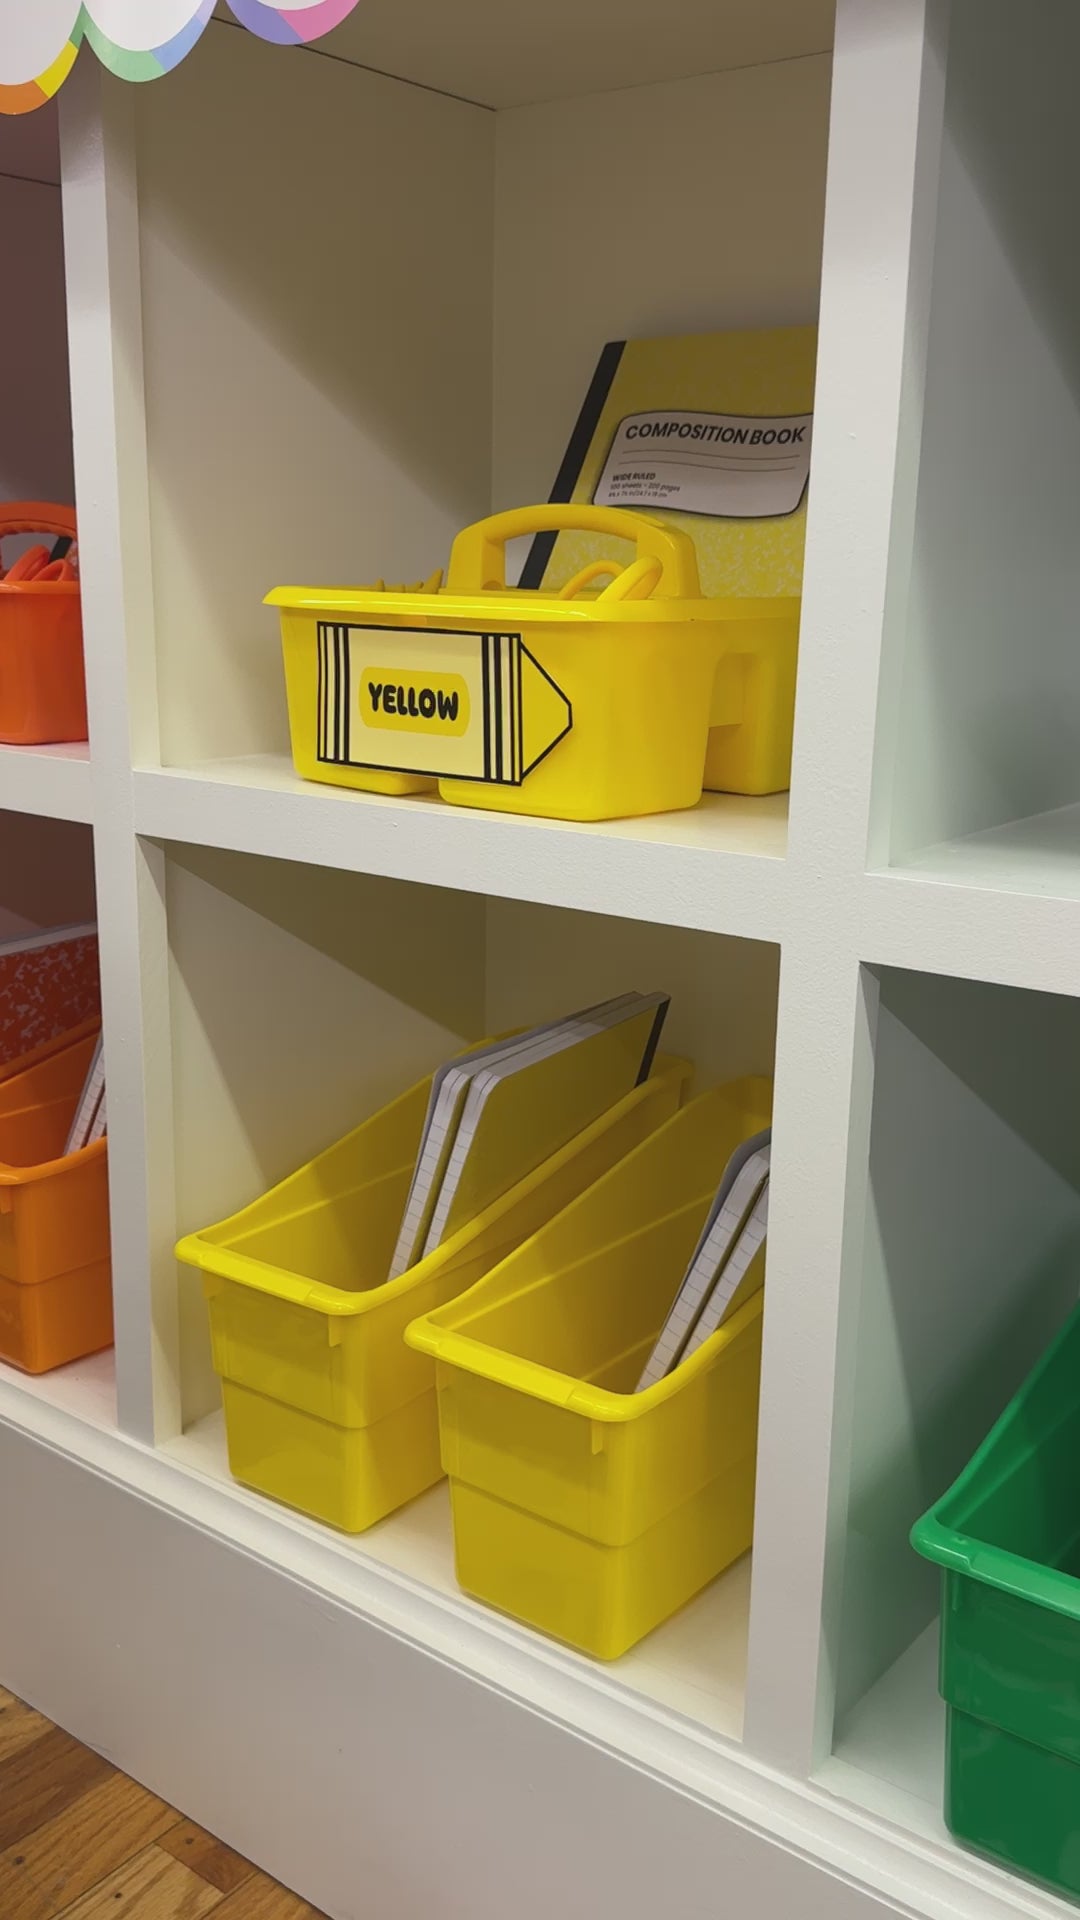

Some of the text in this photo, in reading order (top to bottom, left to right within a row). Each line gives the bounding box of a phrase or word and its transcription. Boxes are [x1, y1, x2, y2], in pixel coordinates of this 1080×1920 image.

[625, 422, 806, 445] COMPOSITION BOOK
[612, 472, 656, 482] WIDE RULED
[660, 485, 681, 493] pages
[368, 681, 459, 721] YELLOW
